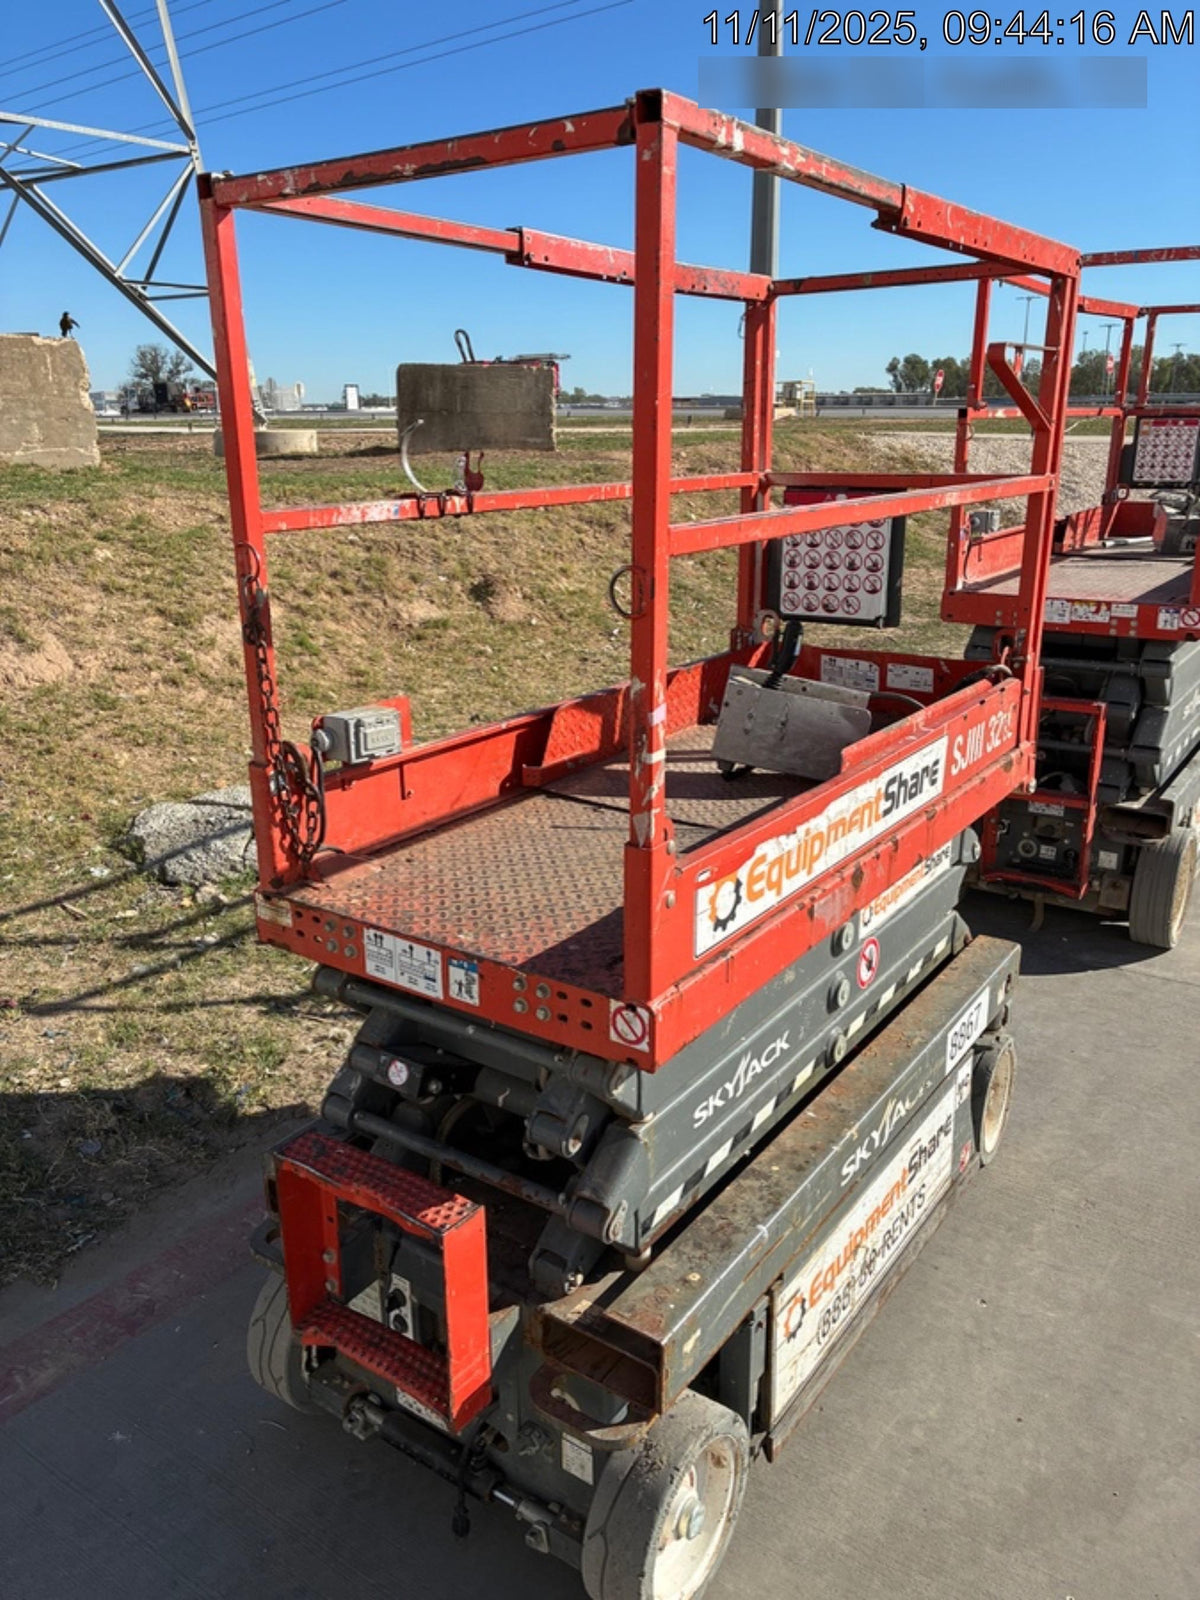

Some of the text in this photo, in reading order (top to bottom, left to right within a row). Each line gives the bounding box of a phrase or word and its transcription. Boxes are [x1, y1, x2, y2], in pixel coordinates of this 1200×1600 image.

[745, 758, 940, 903] EquipmentShare
[692, 1029, 791, 1129] SKYJACK
[949, 1001, 983, 1060] 8867
[808, 1114, 953, 1309] EquipmentShare
